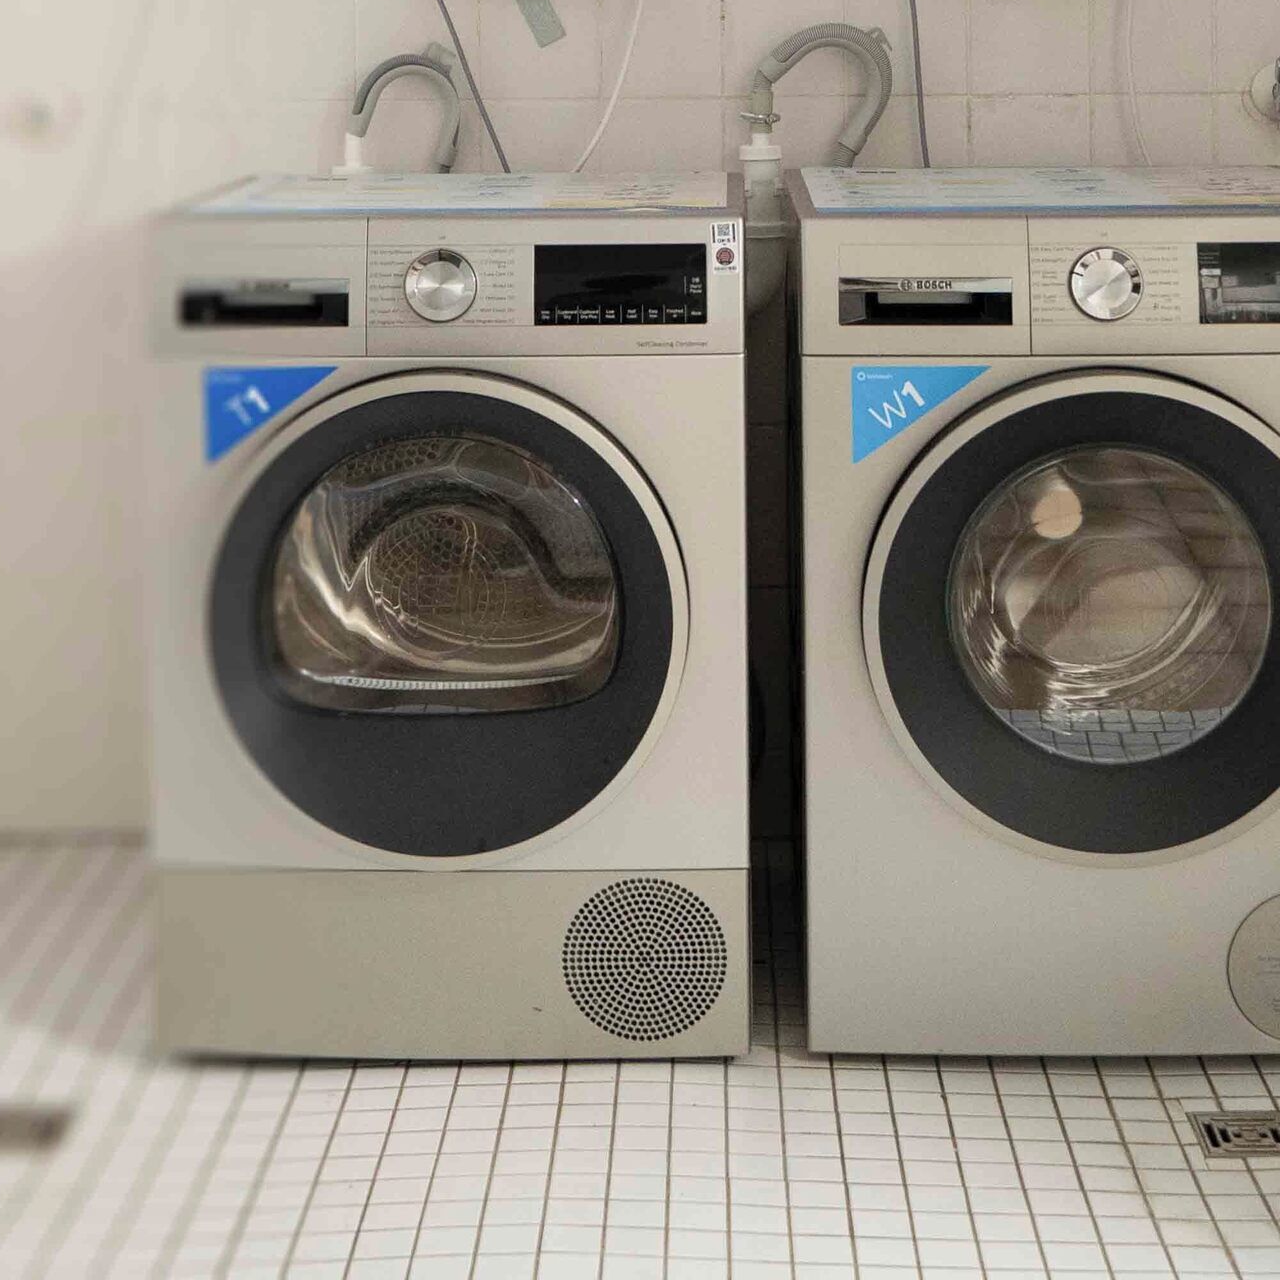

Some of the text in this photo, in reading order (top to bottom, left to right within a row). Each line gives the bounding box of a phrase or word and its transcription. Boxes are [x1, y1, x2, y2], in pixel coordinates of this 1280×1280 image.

[916, 280, 952, 290] BOSCH
[225, 386, 270, 425] T1
[868, 380, 925, 429] W1
